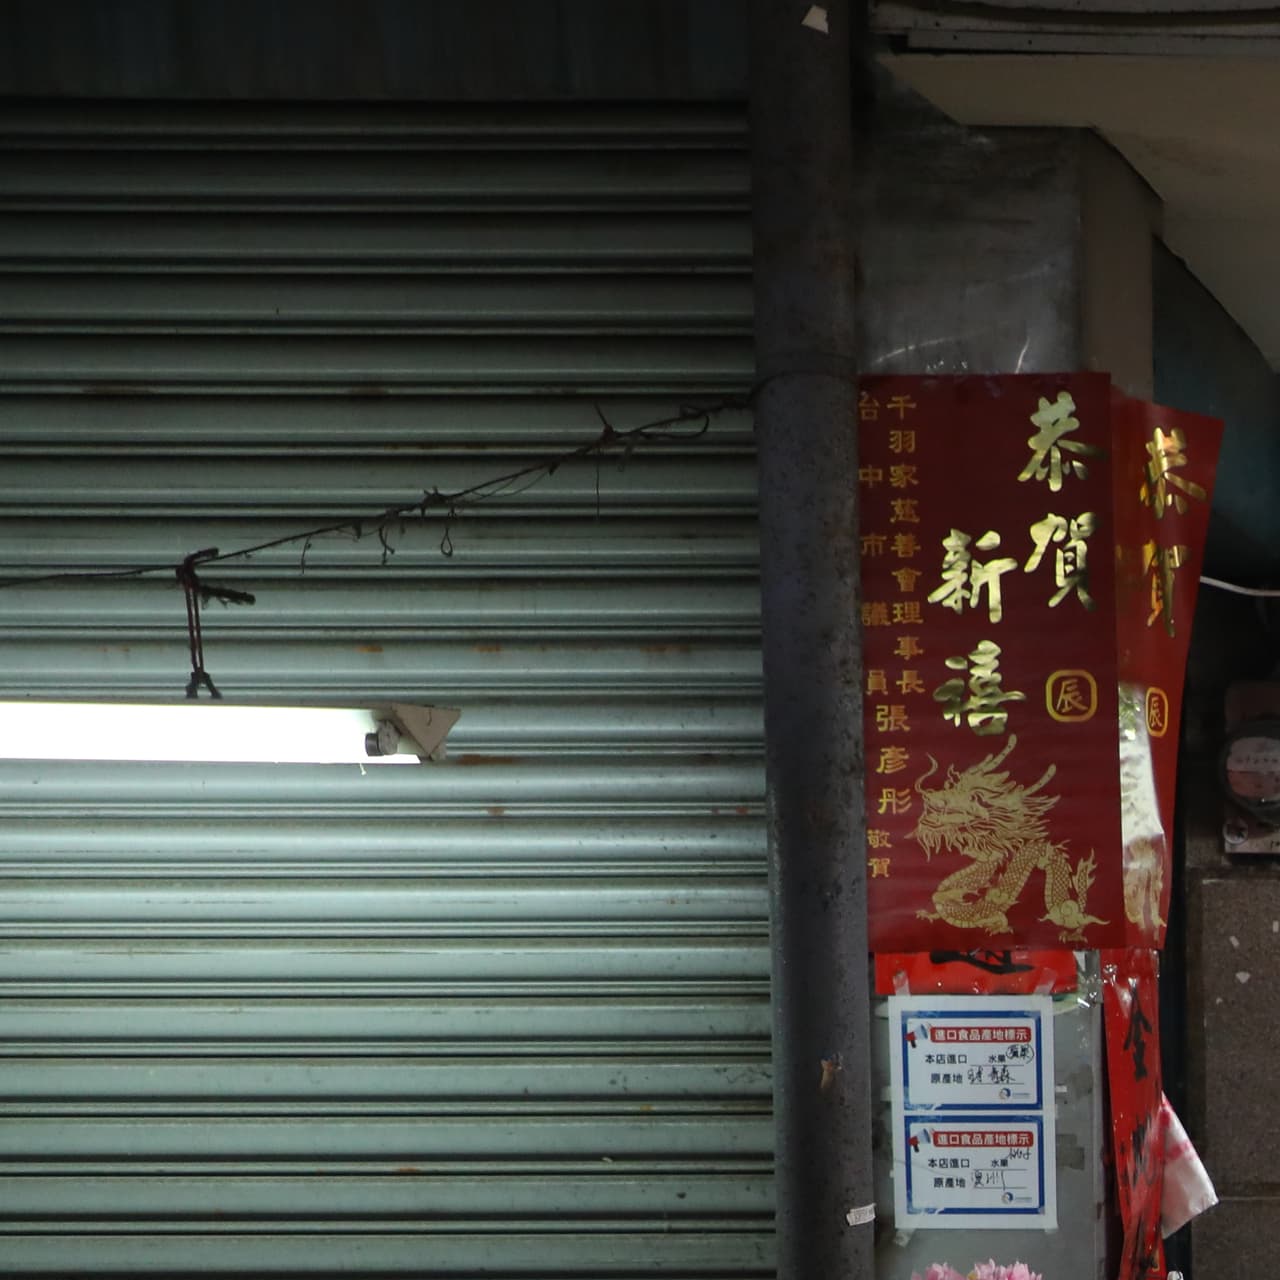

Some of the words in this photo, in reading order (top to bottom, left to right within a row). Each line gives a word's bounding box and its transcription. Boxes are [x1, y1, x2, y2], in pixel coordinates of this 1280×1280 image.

[1017, 391, 1108, 611] 恭賀
[928, 527, 1031, 736] 新禧
[935, 1029, 1027, 1041] 進口食品產地標示
[925, 1053, 967, 1065] 本店進口
[931, 1073, 963, 1084] 原產地
[937, 1133, 1030, 1145] 進口食品產地標示
[928, 1158, 970, 1169] 本店進口
[934, 1177, 966, 1188] 原產地
